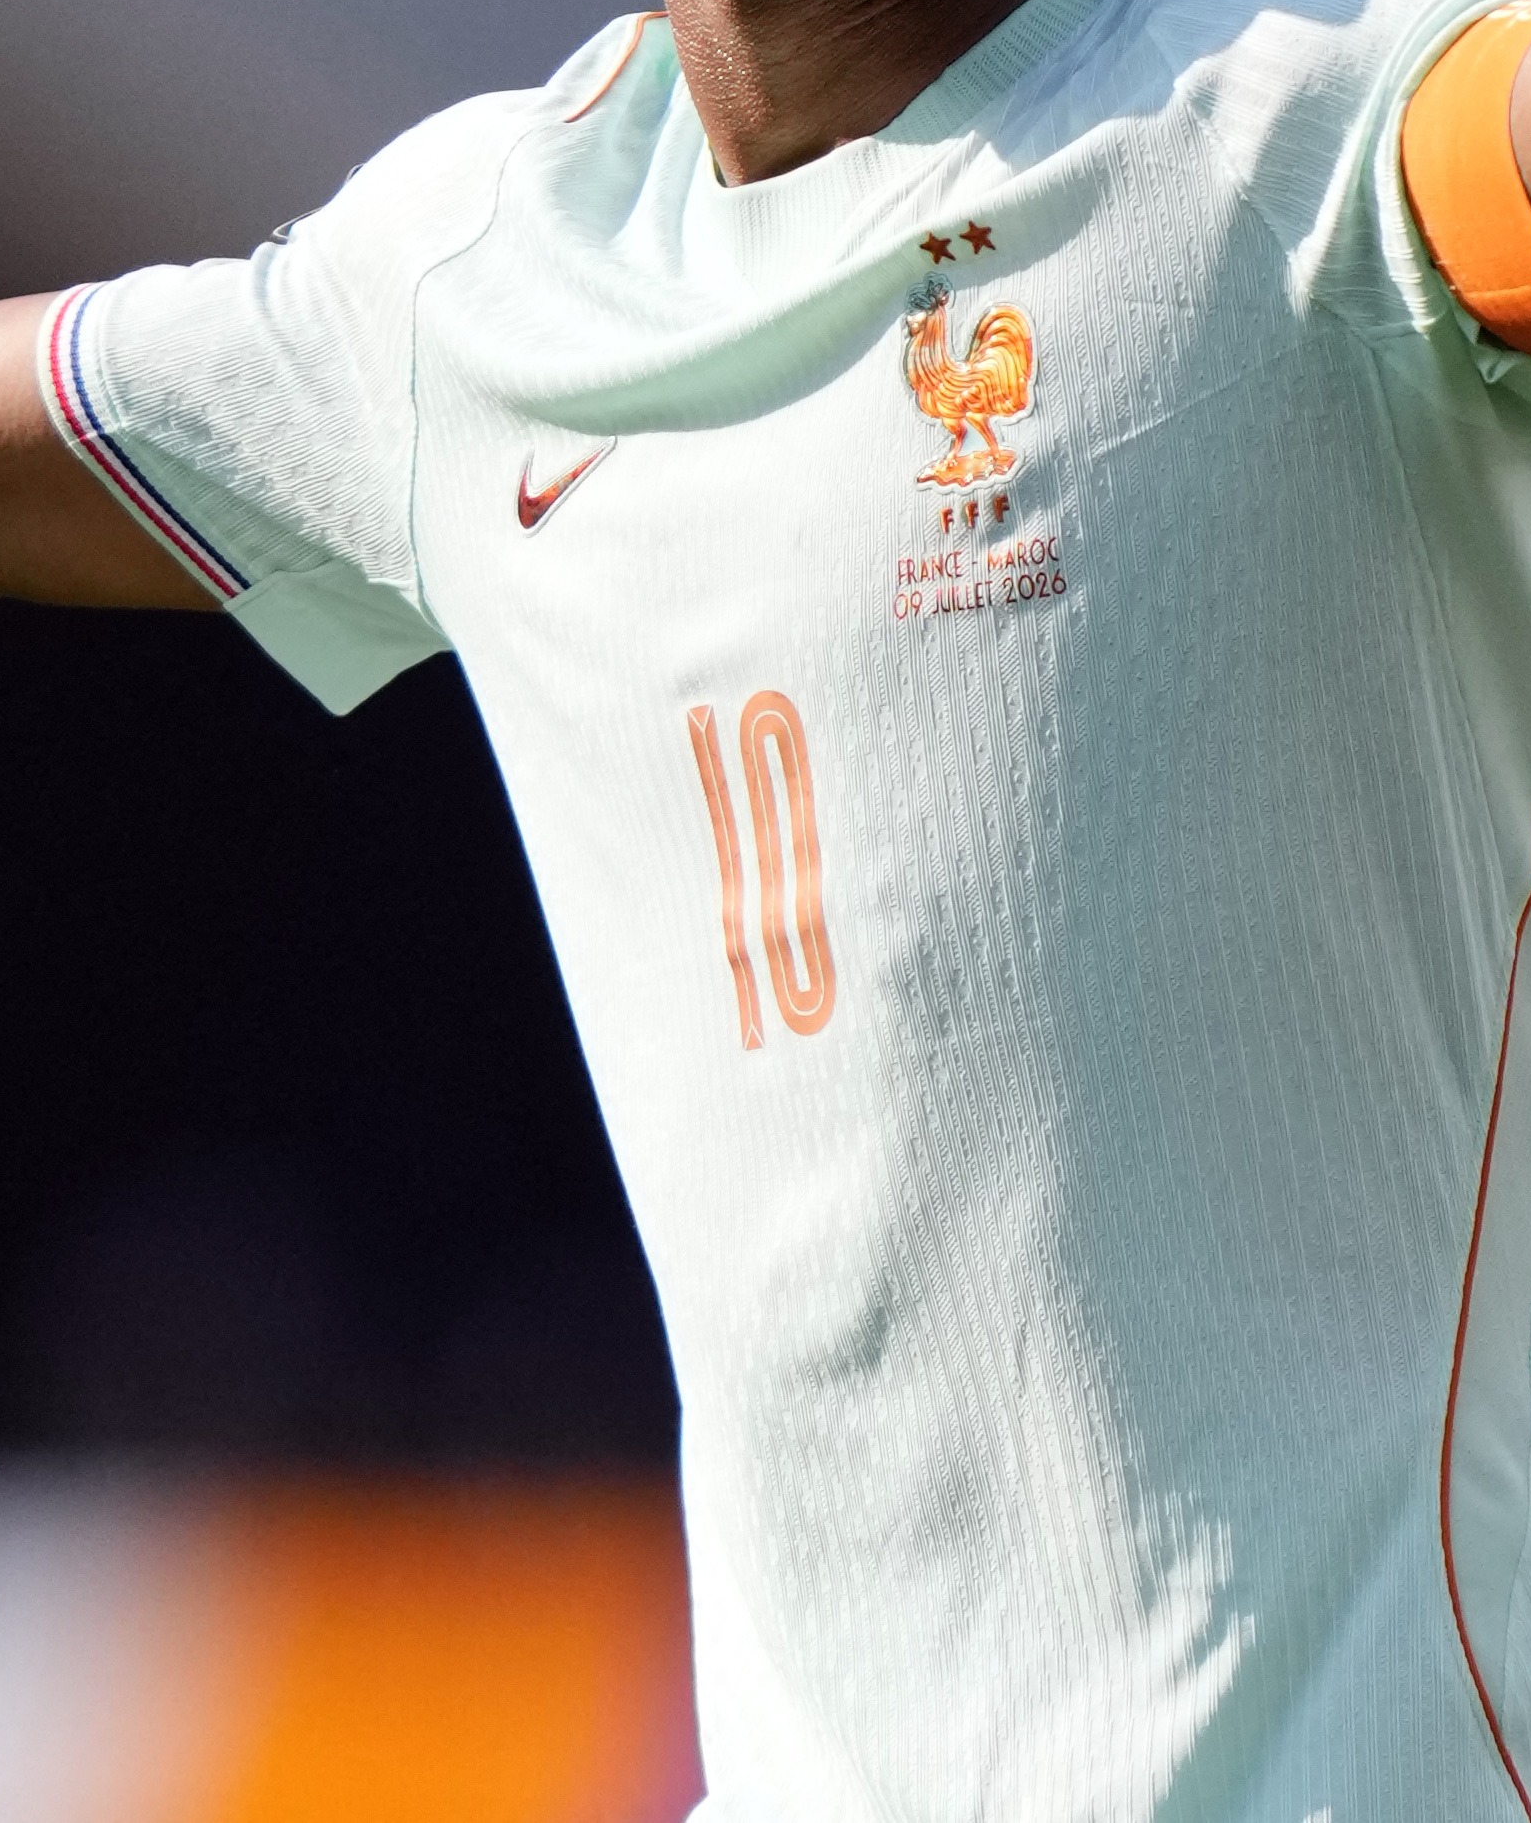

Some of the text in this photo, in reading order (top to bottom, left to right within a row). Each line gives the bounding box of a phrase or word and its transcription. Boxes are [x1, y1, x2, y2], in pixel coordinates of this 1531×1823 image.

[897, 551, 963, 586] FRANCE
[987, 536, 1060, 574] MAROC
[893, 568, 1068, 620] 09 JUILLET 2026
[686, 689, 836, 1051] 10
